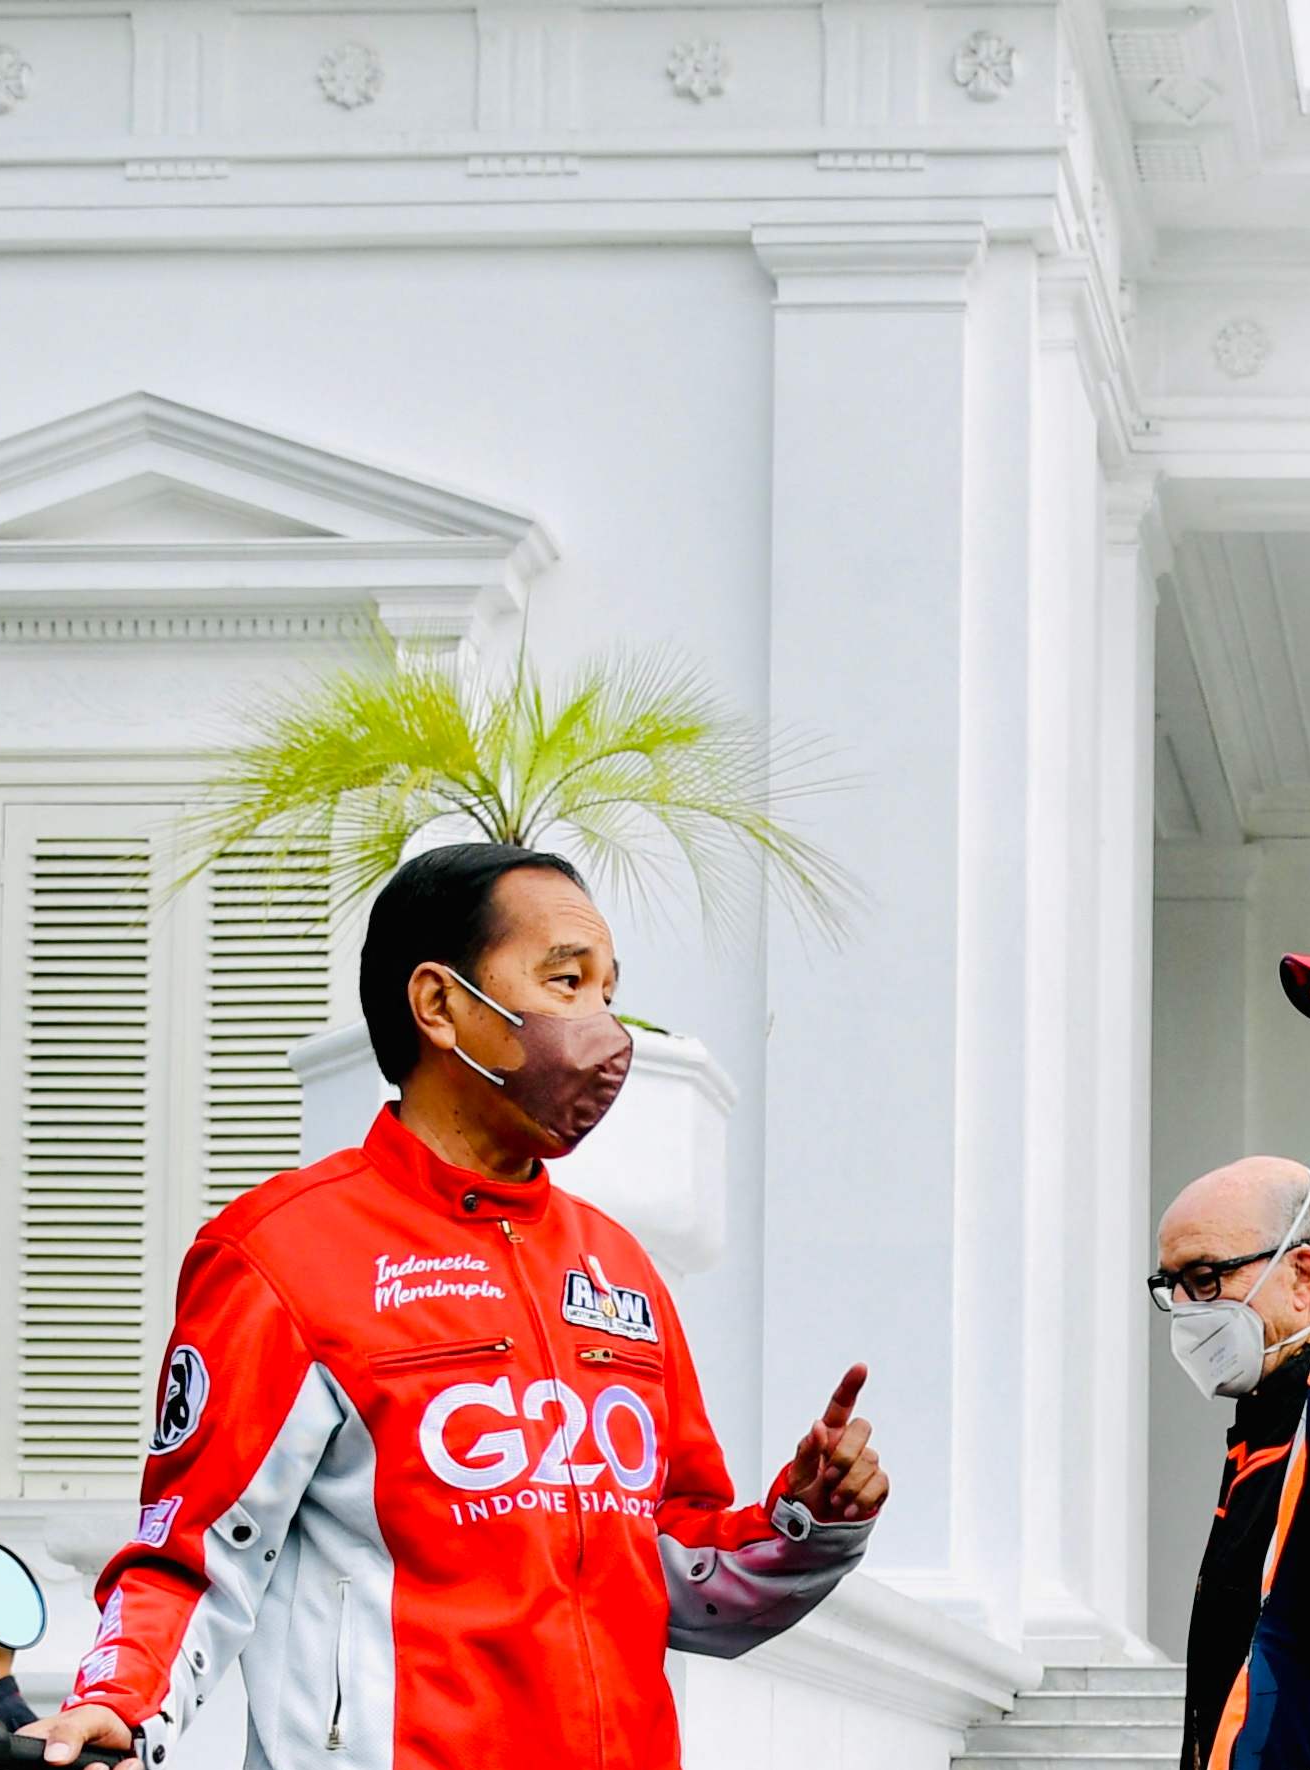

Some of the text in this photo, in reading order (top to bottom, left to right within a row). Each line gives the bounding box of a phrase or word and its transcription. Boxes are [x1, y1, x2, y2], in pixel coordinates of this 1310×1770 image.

[374, 1253, 490, 1285] Indonesia
[374, 1279, 506, 1313] Memimpin
[418, 1375, 659, 1492] G20
[449, 1488, 620, 1526] INDONESIA
